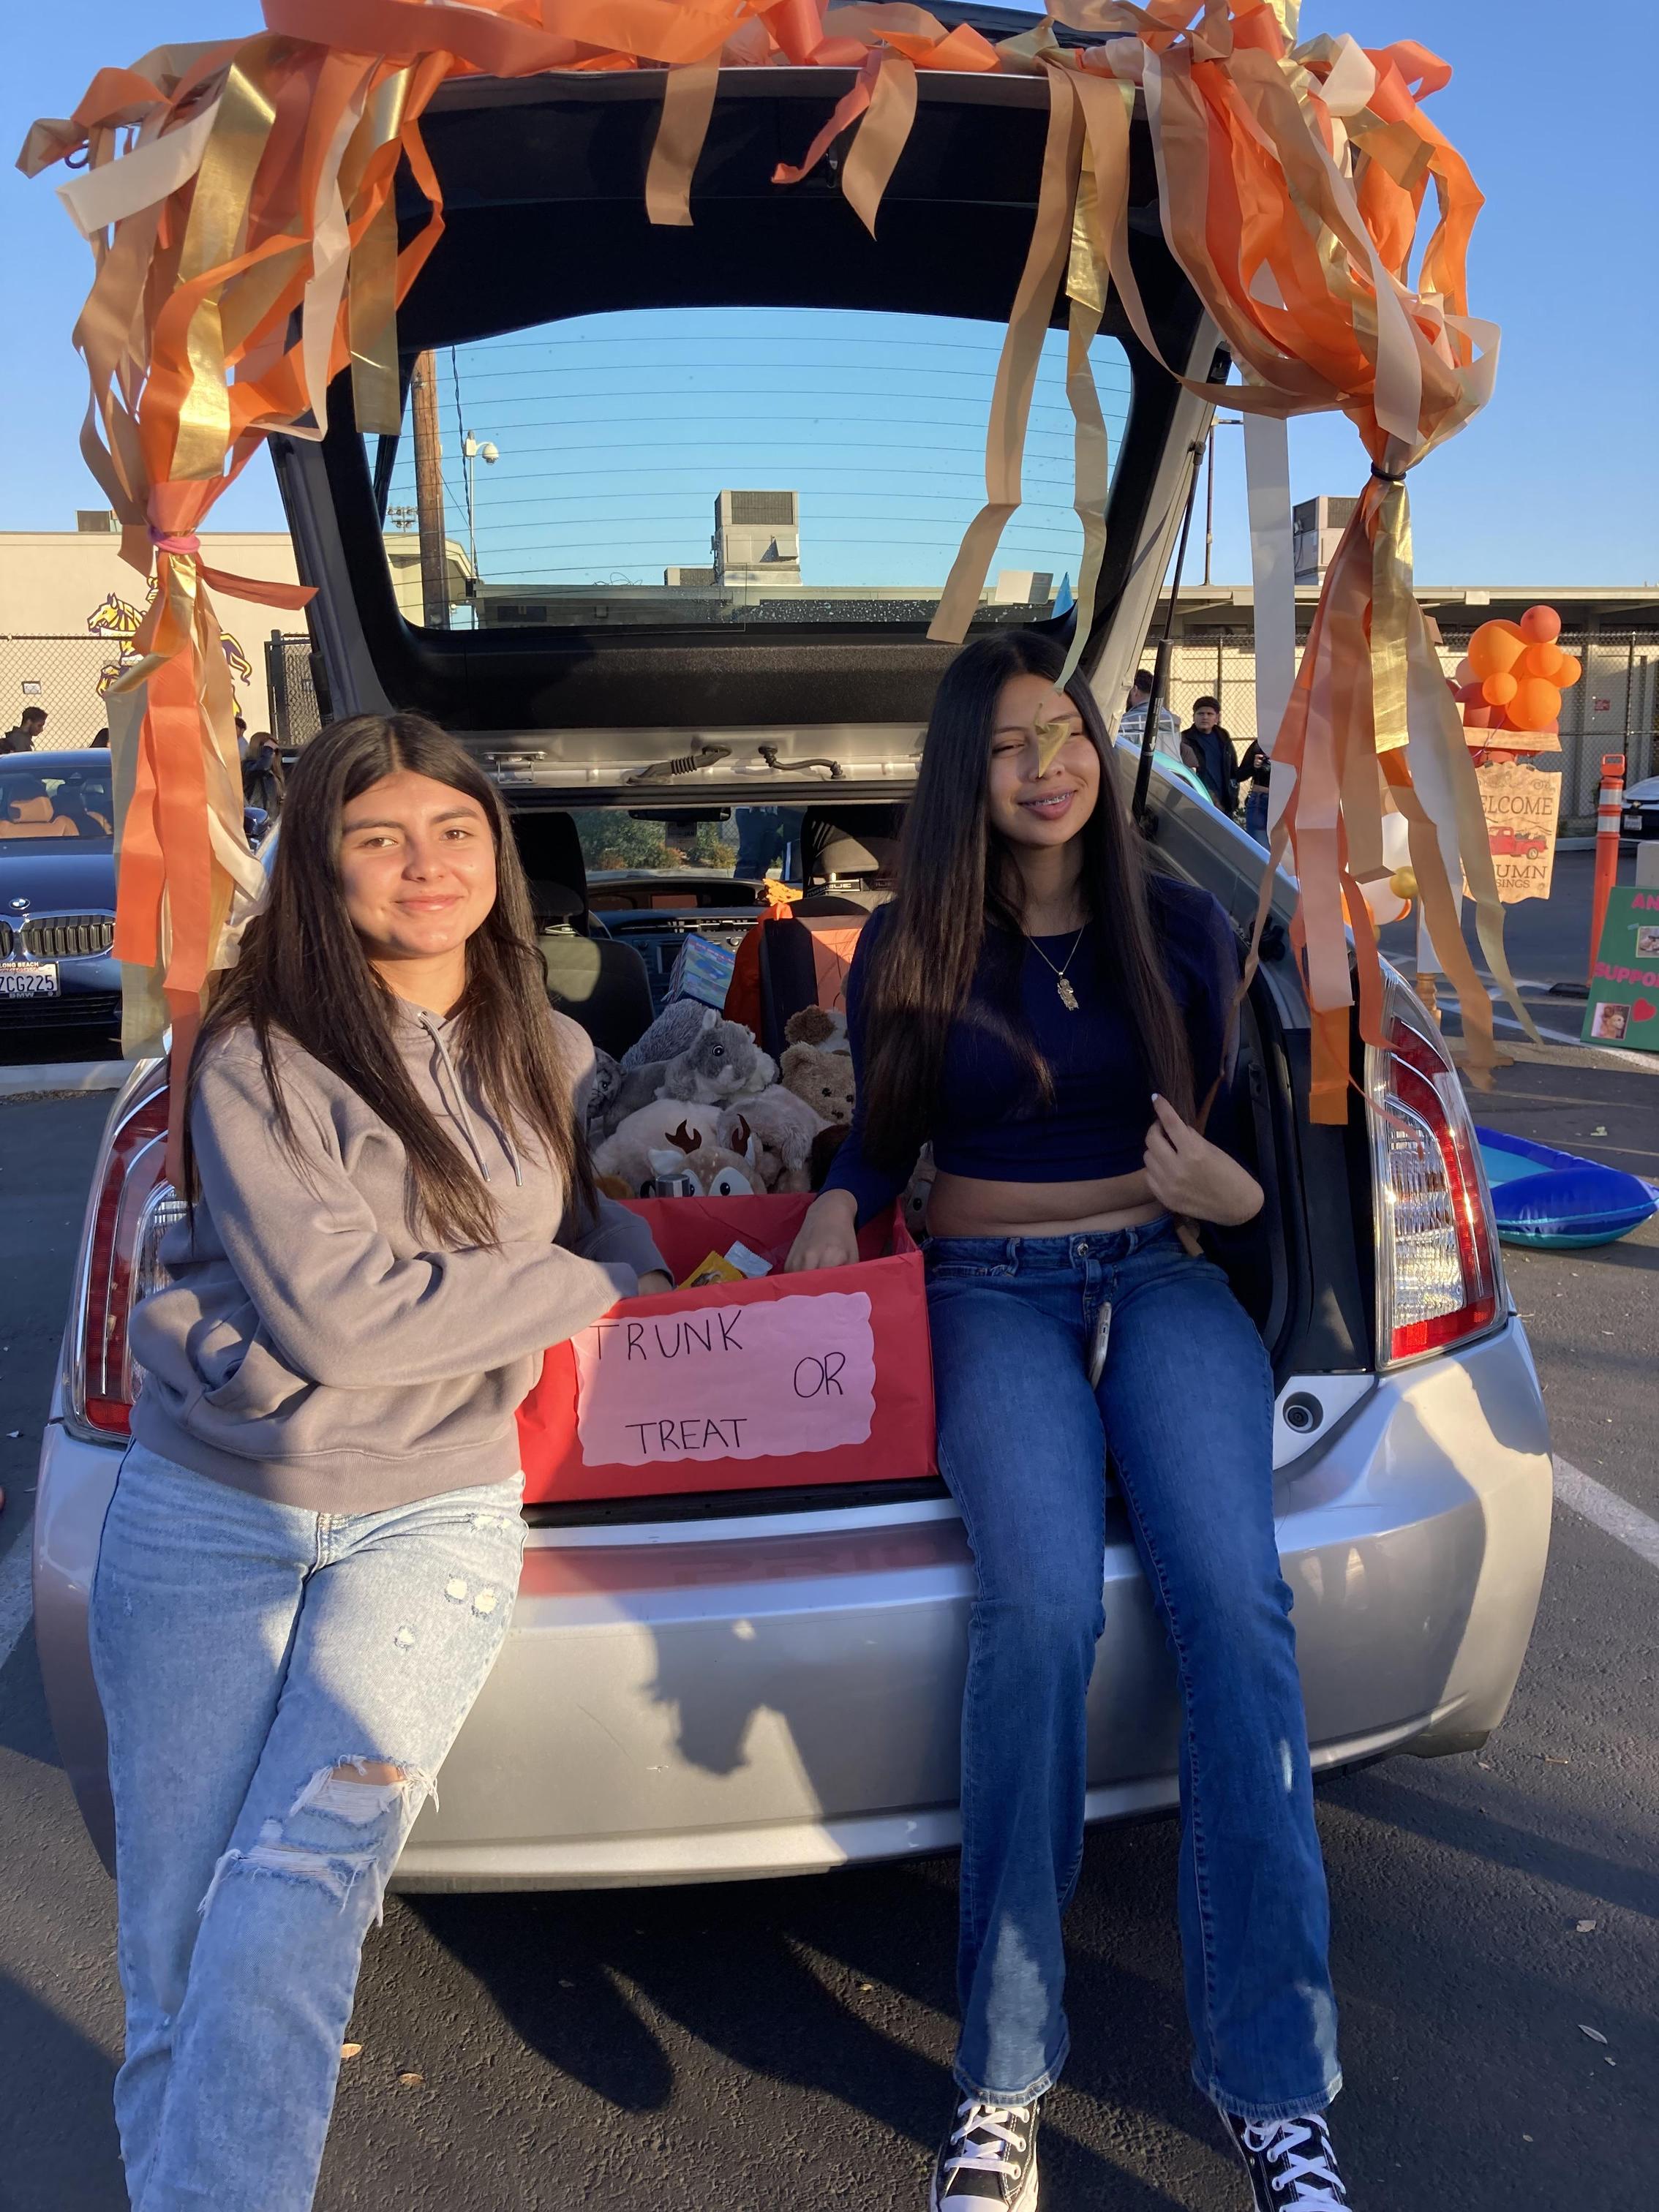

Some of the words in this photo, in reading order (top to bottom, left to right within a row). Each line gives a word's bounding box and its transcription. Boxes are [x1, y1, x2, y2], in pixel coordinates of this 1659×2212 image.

[1481, 795, 1553, 816] ELCOME
[1496, 865, 1548, 879] UMN
[1496, 879, 1530, 889] SINGS
[1594, 961, 1659, 988] SUPPO
[589, 1309, 743, 1361] TRUNK
[794, 1351, 846, 1399] OR
[625, 1418, 748, 1454] TREAT
